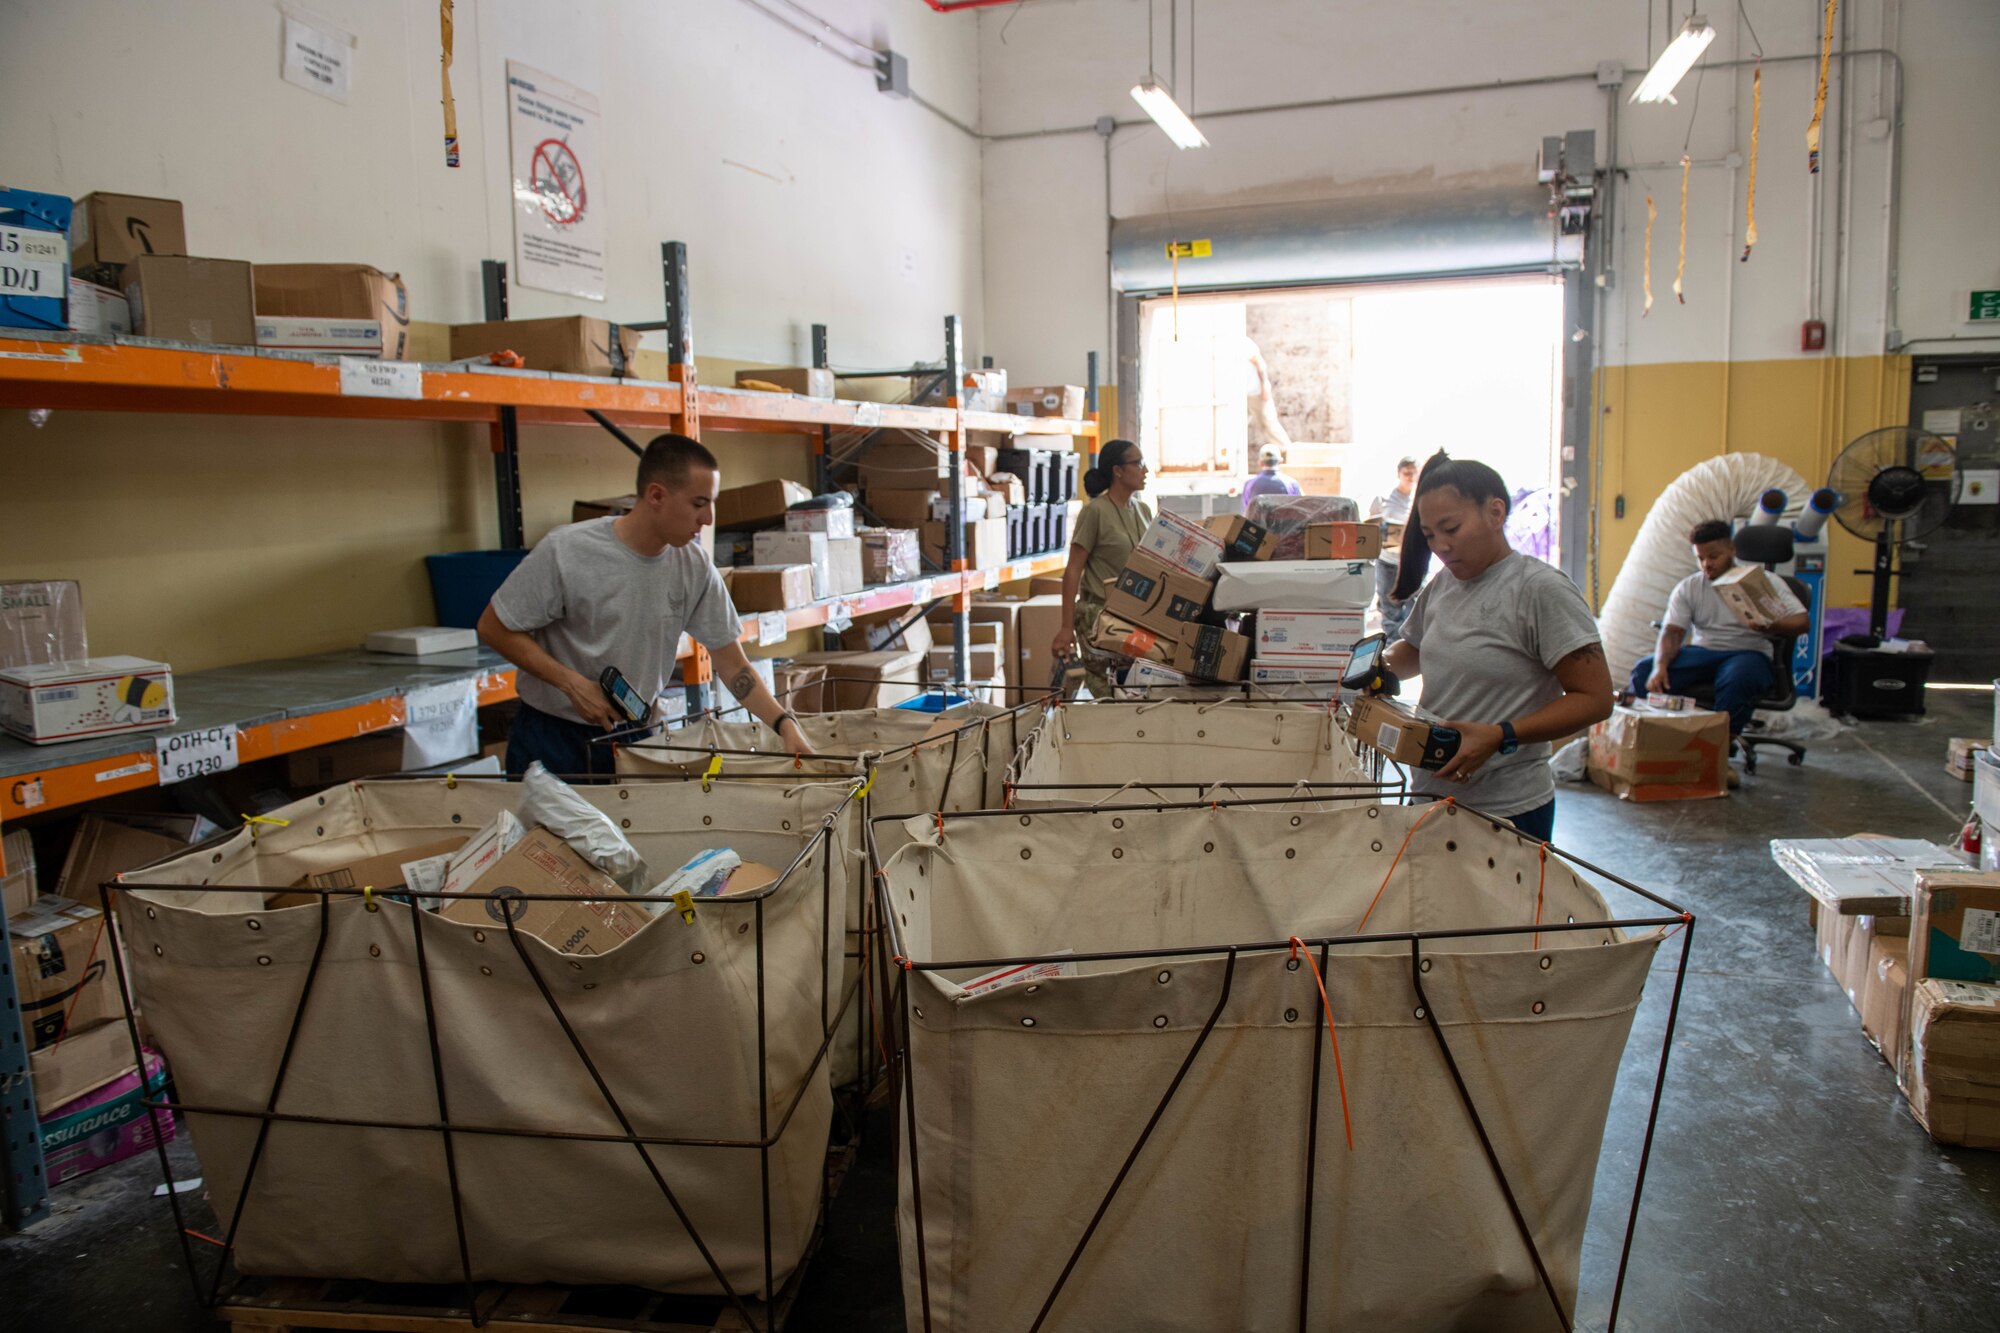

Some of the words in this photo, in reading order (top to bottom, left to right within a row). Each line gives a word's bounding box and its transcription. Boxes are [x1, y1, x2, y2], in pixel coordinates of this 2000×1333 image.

[25, 243, 57, 256] 61241
[2, 594, 50, 610] SMALL
[170, 728, 225, 751] OTH-CT
[177, 755, 222, 778] 61230
[42, 1103, 130, 1150] ssurance
